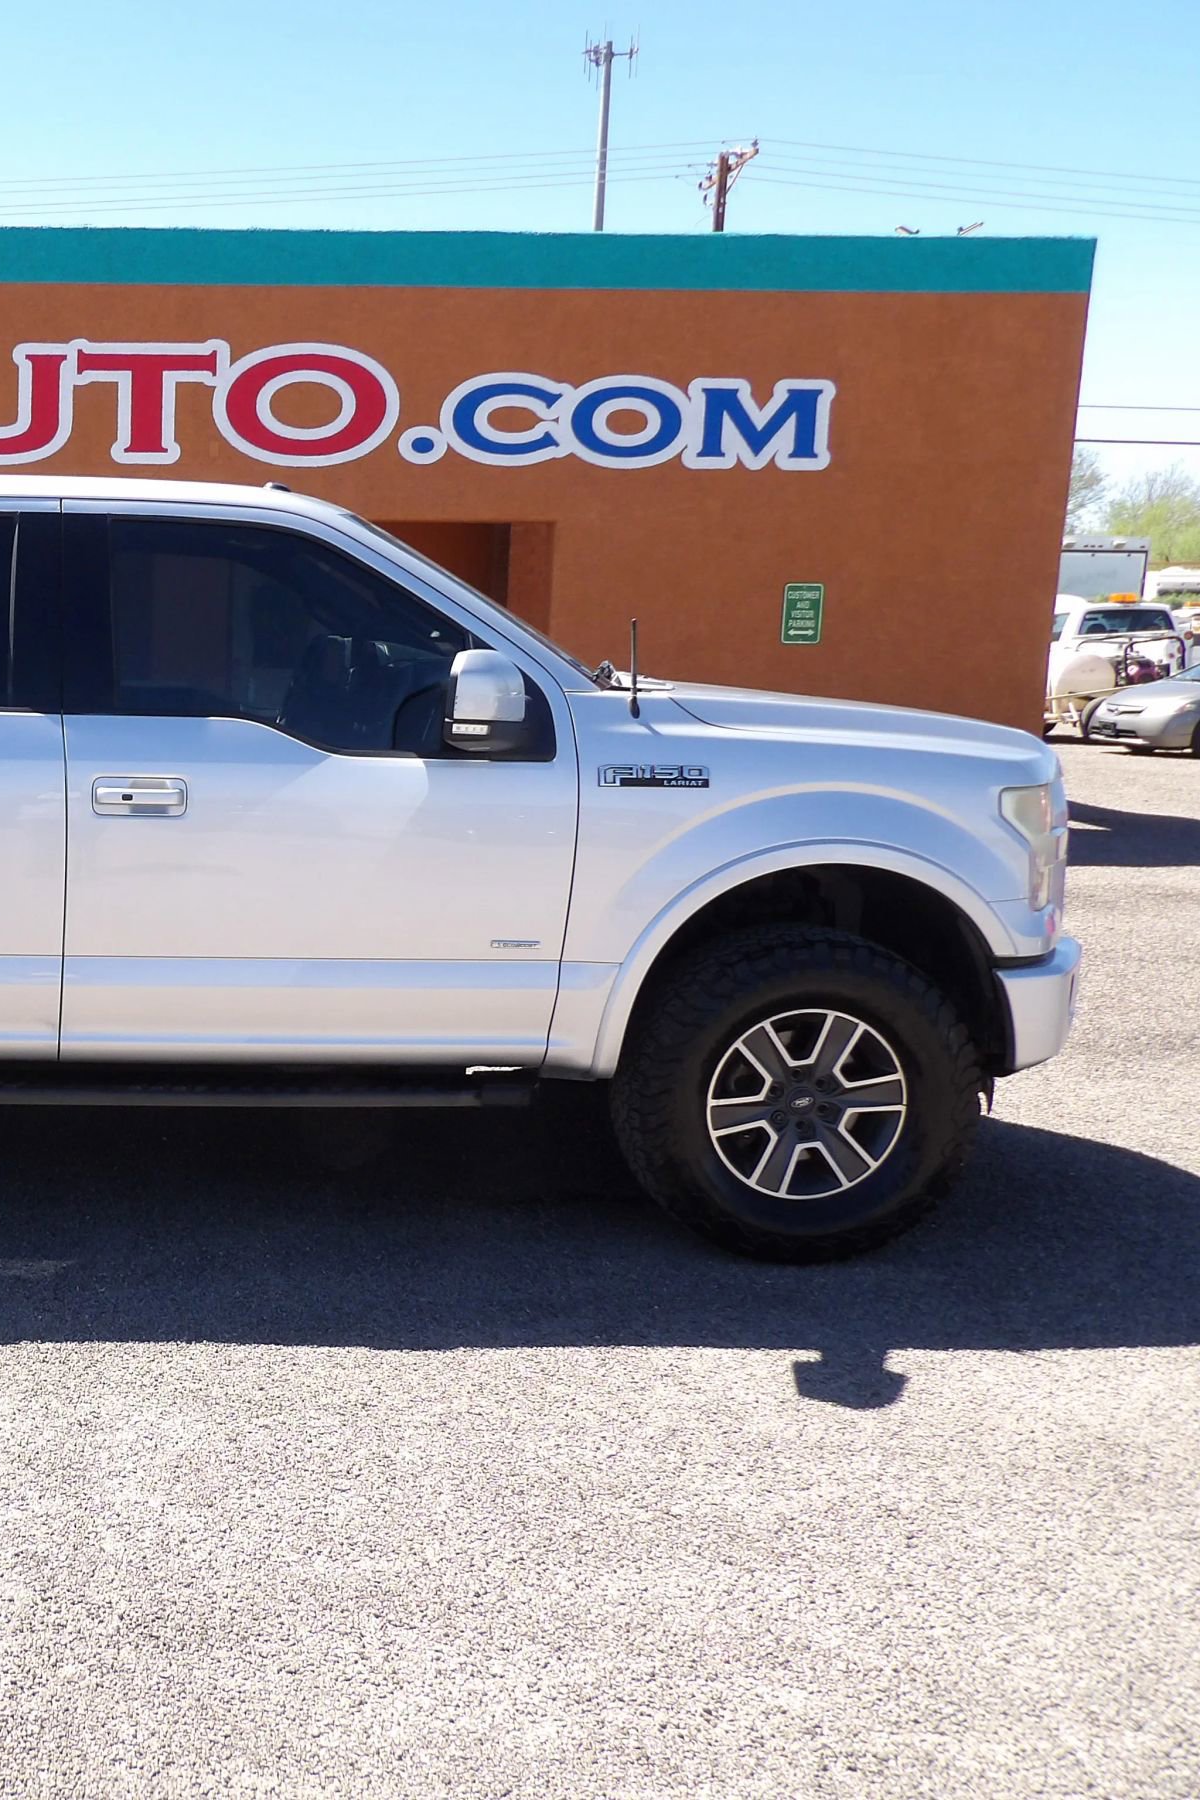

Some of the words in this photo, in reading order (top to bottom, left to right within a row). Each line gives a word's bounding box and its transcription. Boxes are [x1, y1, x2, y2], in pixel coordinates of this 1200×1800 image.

[787, 591, 820, 599] CUSTOMER
[796, 601, 810, 609] AND
[791, 610, 814, 618] VISITOR
[788, 619, 816, 627] PARKING
